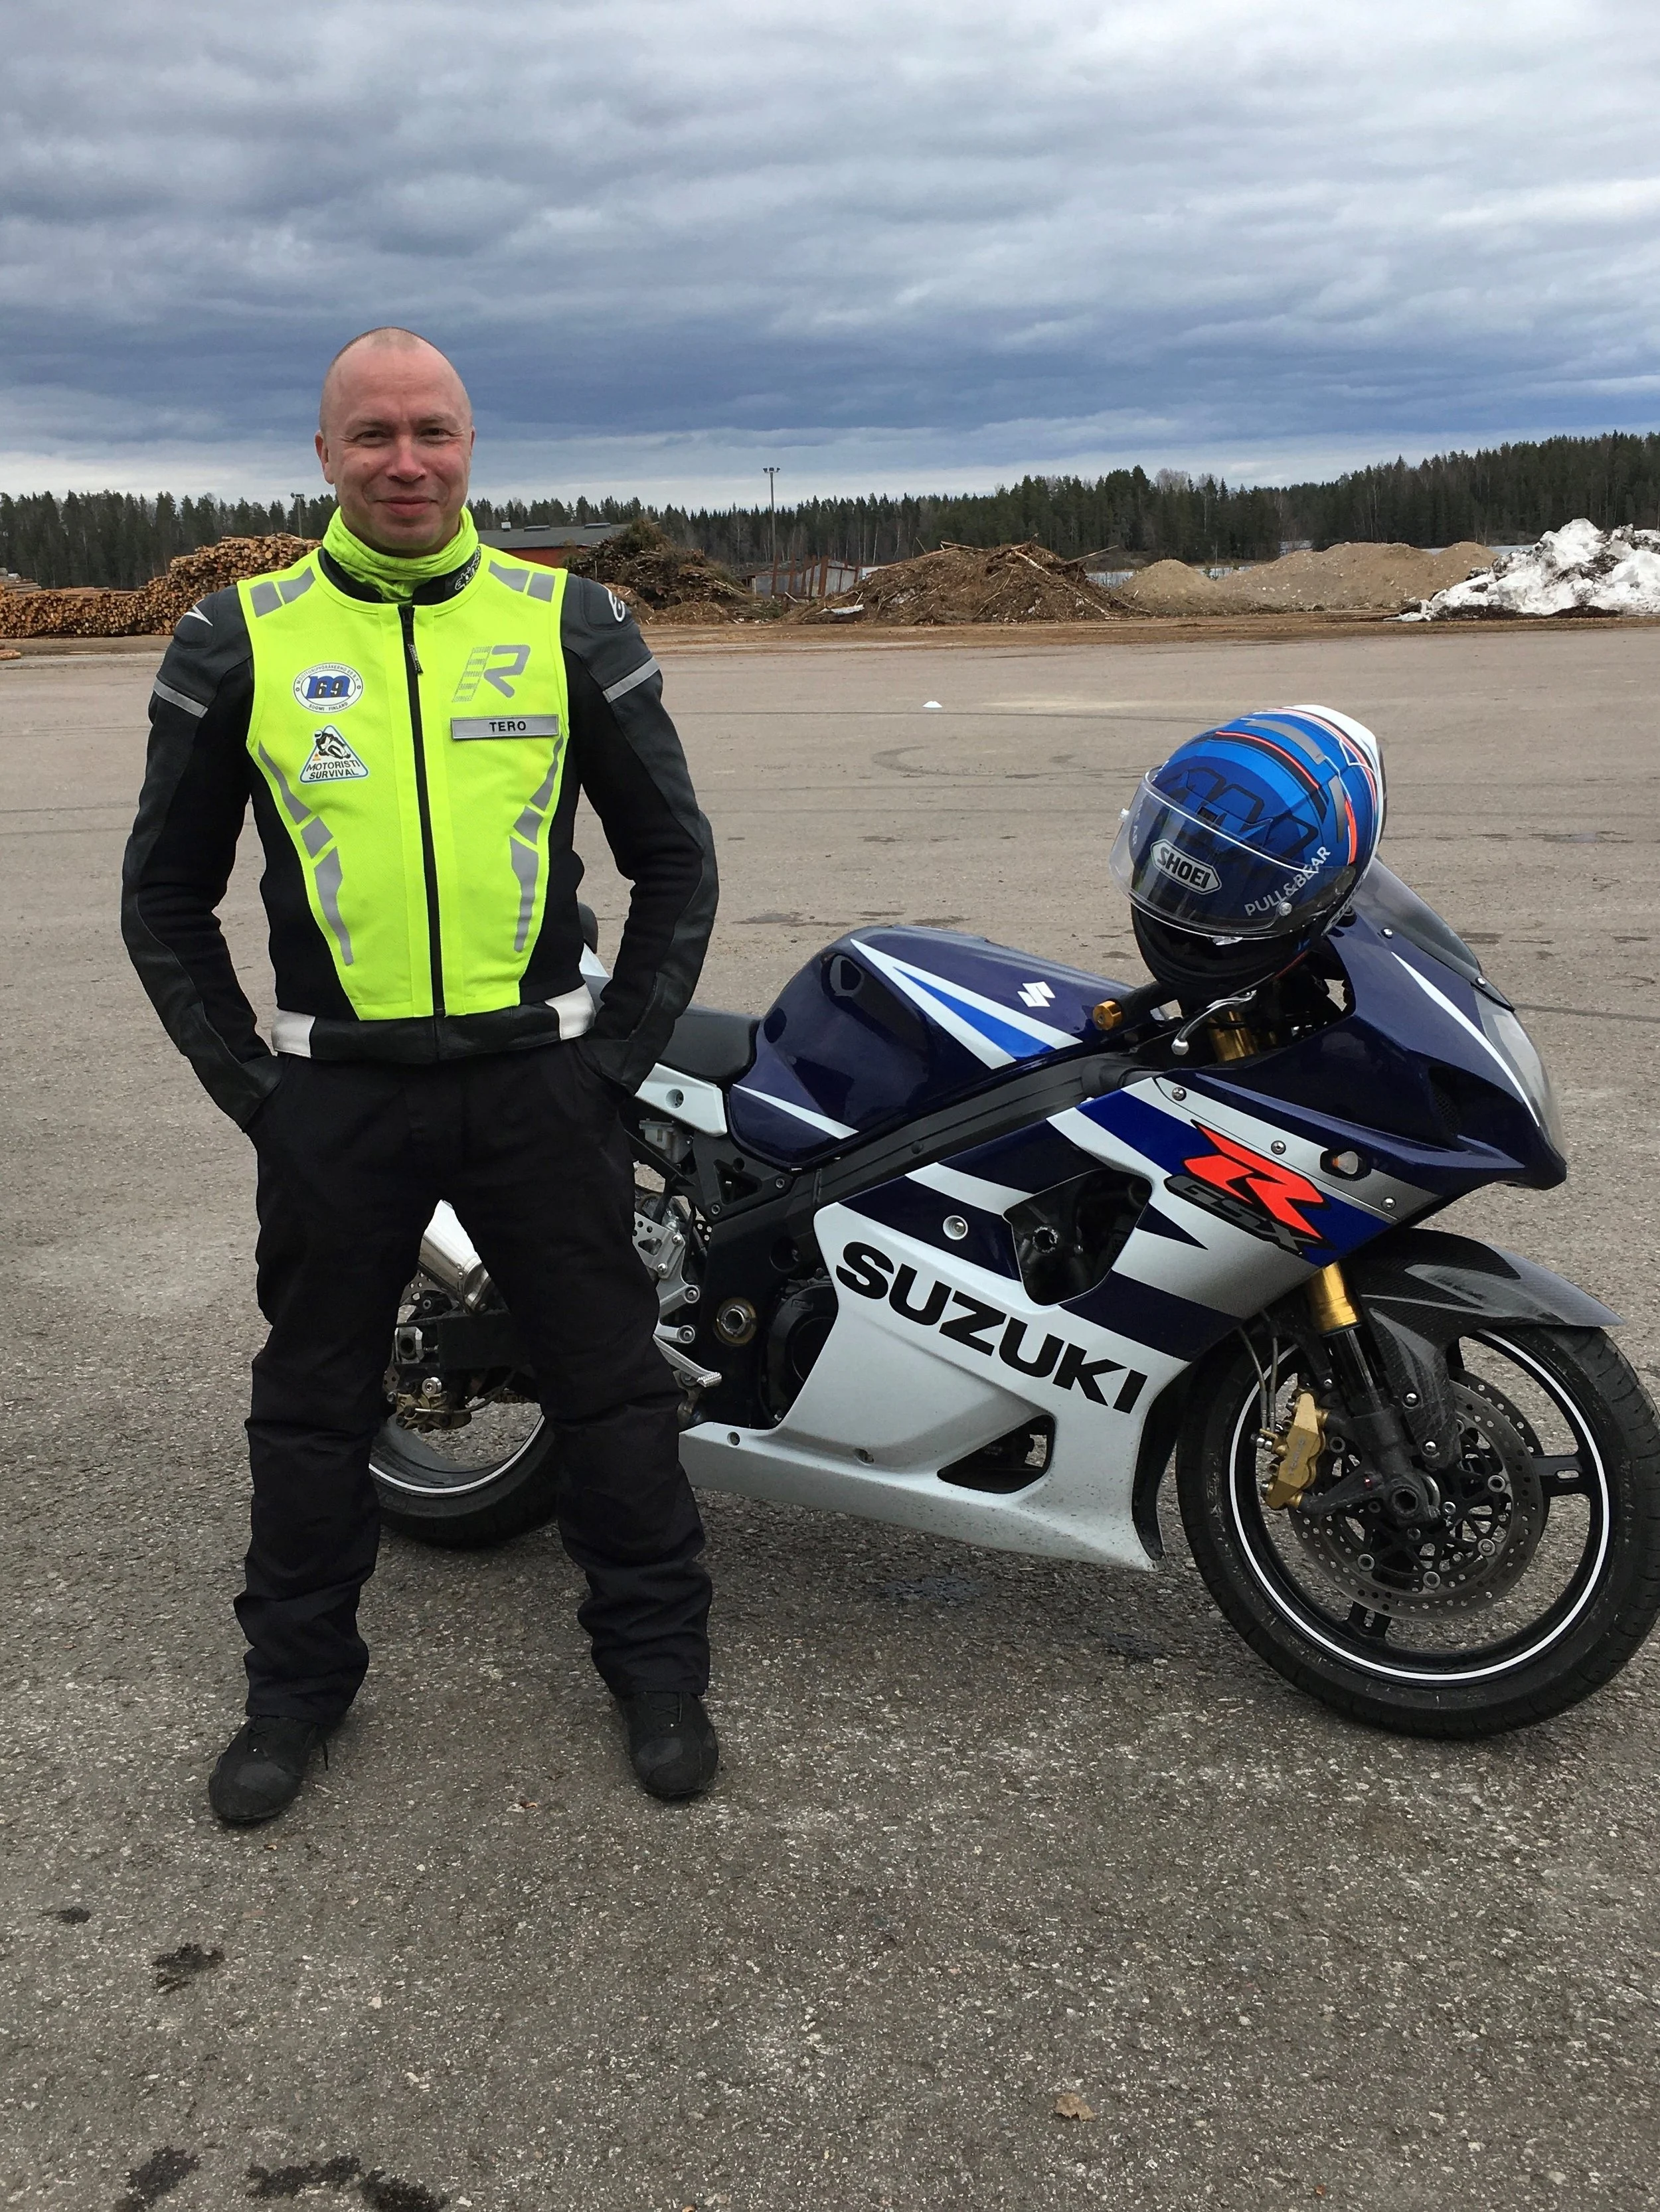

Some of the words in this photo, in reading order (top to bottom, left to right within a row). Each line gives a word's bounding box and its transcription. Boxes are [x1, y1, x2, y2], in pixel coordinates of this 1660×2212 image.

[328, 702, 349, 711] FINLAND
[489, 720, 527, 732] TERO
[305, 759, 361, 772] MOTORISTI
[309, 767, 360, 780] SURVIVAL
[1157, 846, 1211, 889] SHOEI
[1244, 846, 1331, 916] PULL&BEAR
[1166, 1175, 1319, 1252] GSX
[835, 1241, 1147, 1414] SUZUKI
